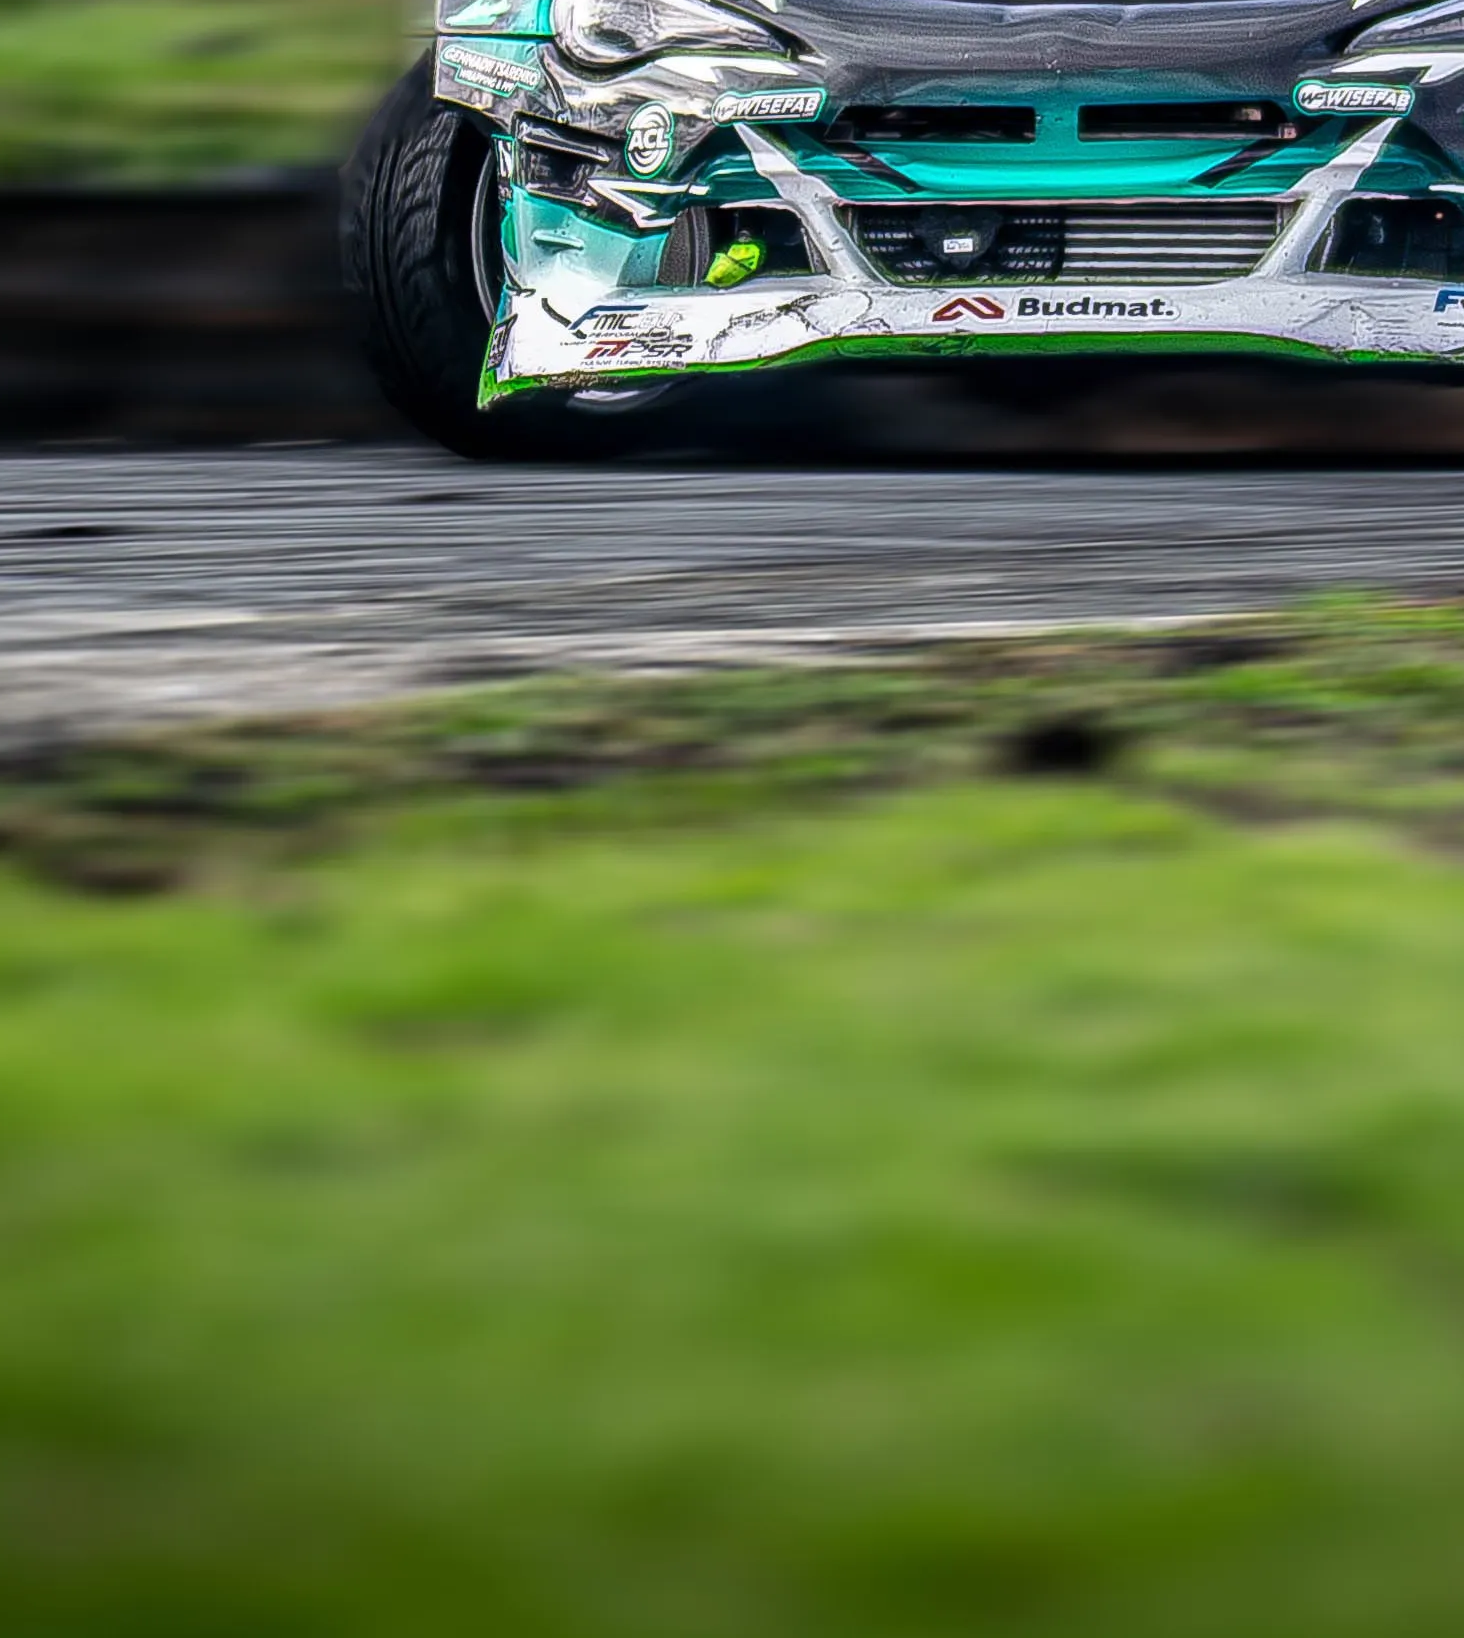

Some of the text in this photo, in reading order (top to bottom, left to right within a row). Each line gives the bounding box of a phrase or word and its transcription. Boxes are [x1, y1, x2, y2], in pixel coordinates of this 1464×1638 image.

[736, 96, 818, 116] WISEFAB
[1326, 89, 1411, 107] WISEFAB
[628, 127, 668, 152] ACL
[1017, 297, 1174, 318] Budmat.
[620, 344, 693, 358] PSR
